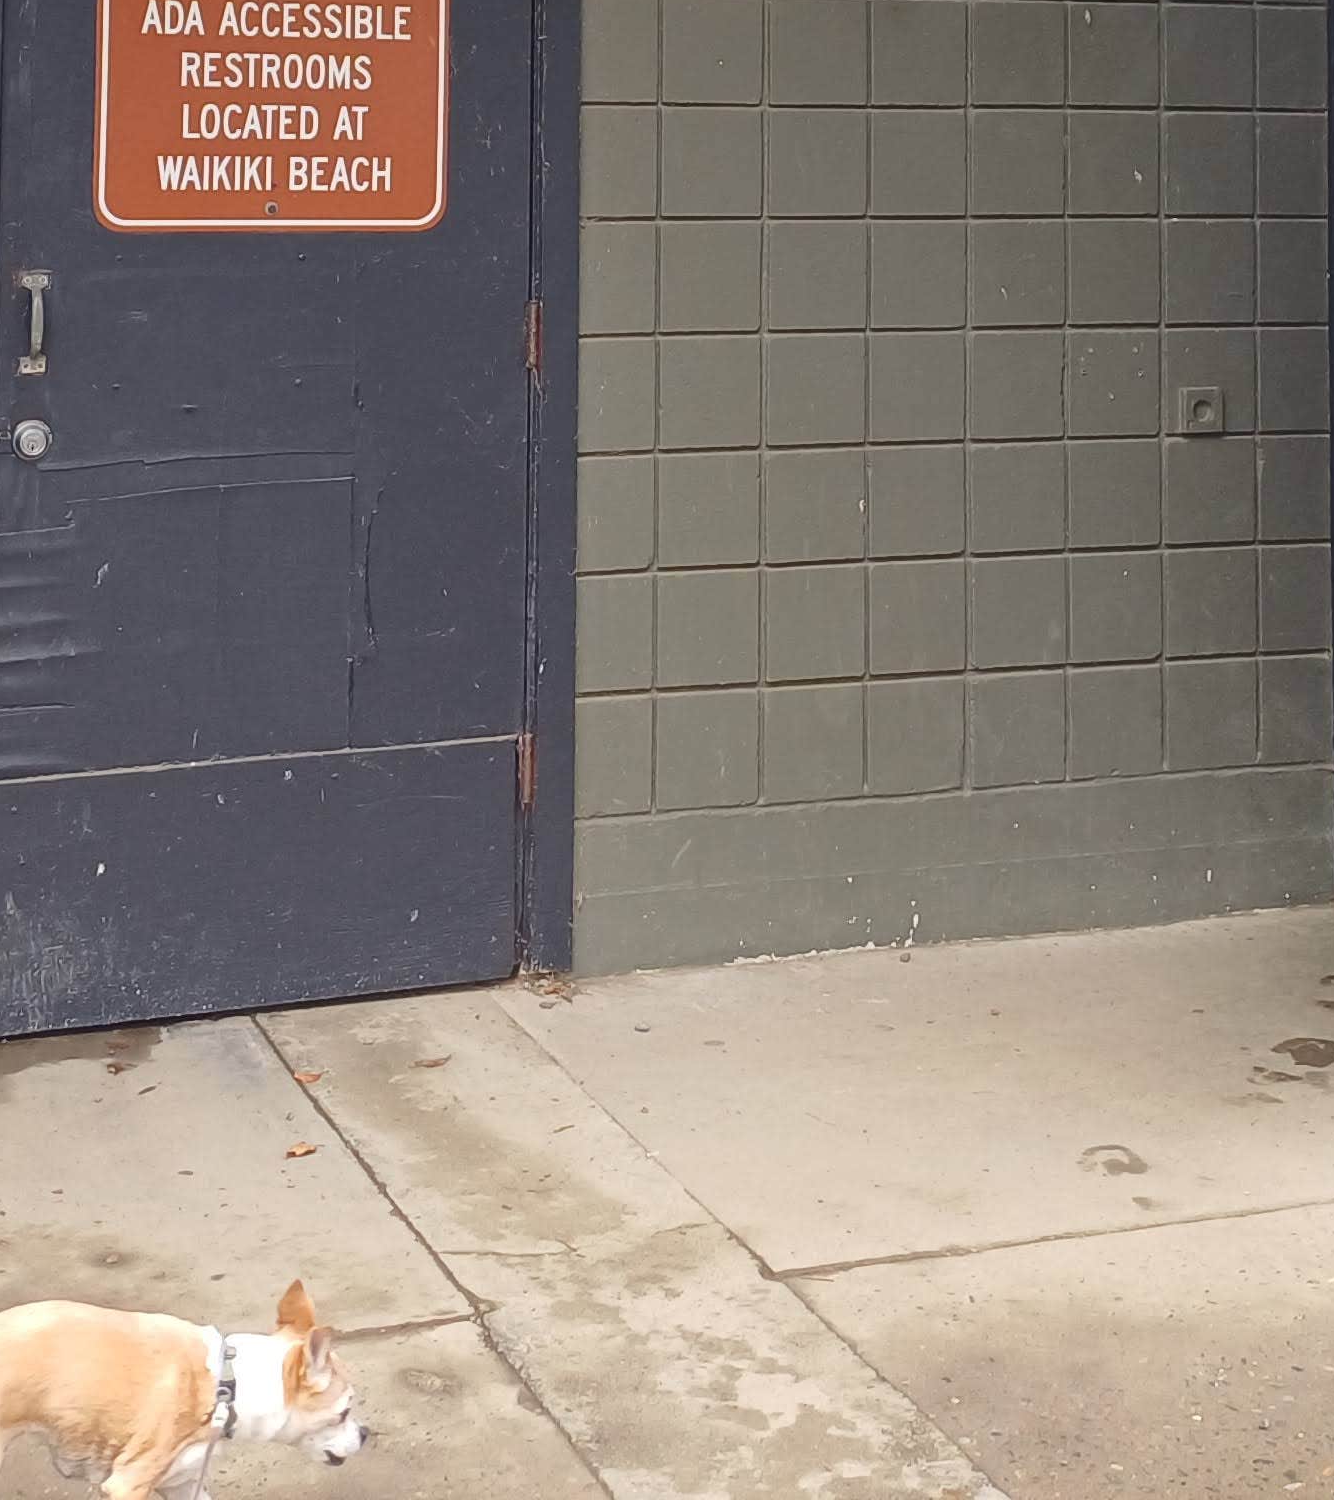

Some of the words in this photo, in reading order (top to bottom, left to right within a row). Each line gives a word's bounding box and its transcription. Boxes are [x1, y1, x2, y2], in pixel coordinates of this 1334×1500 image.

[141, 0, 205, 36] ADA
[218, 1, 412, 41] ACCESSIBLE
[181, 51, 372, 90] RESTROOMS
[182, 103, 319, 140] LOCATED
[333, 105, 369, 141] AT
[157, 155, 273, 191] WAIKIKI
[288, 156, 391, 192] BEACH
